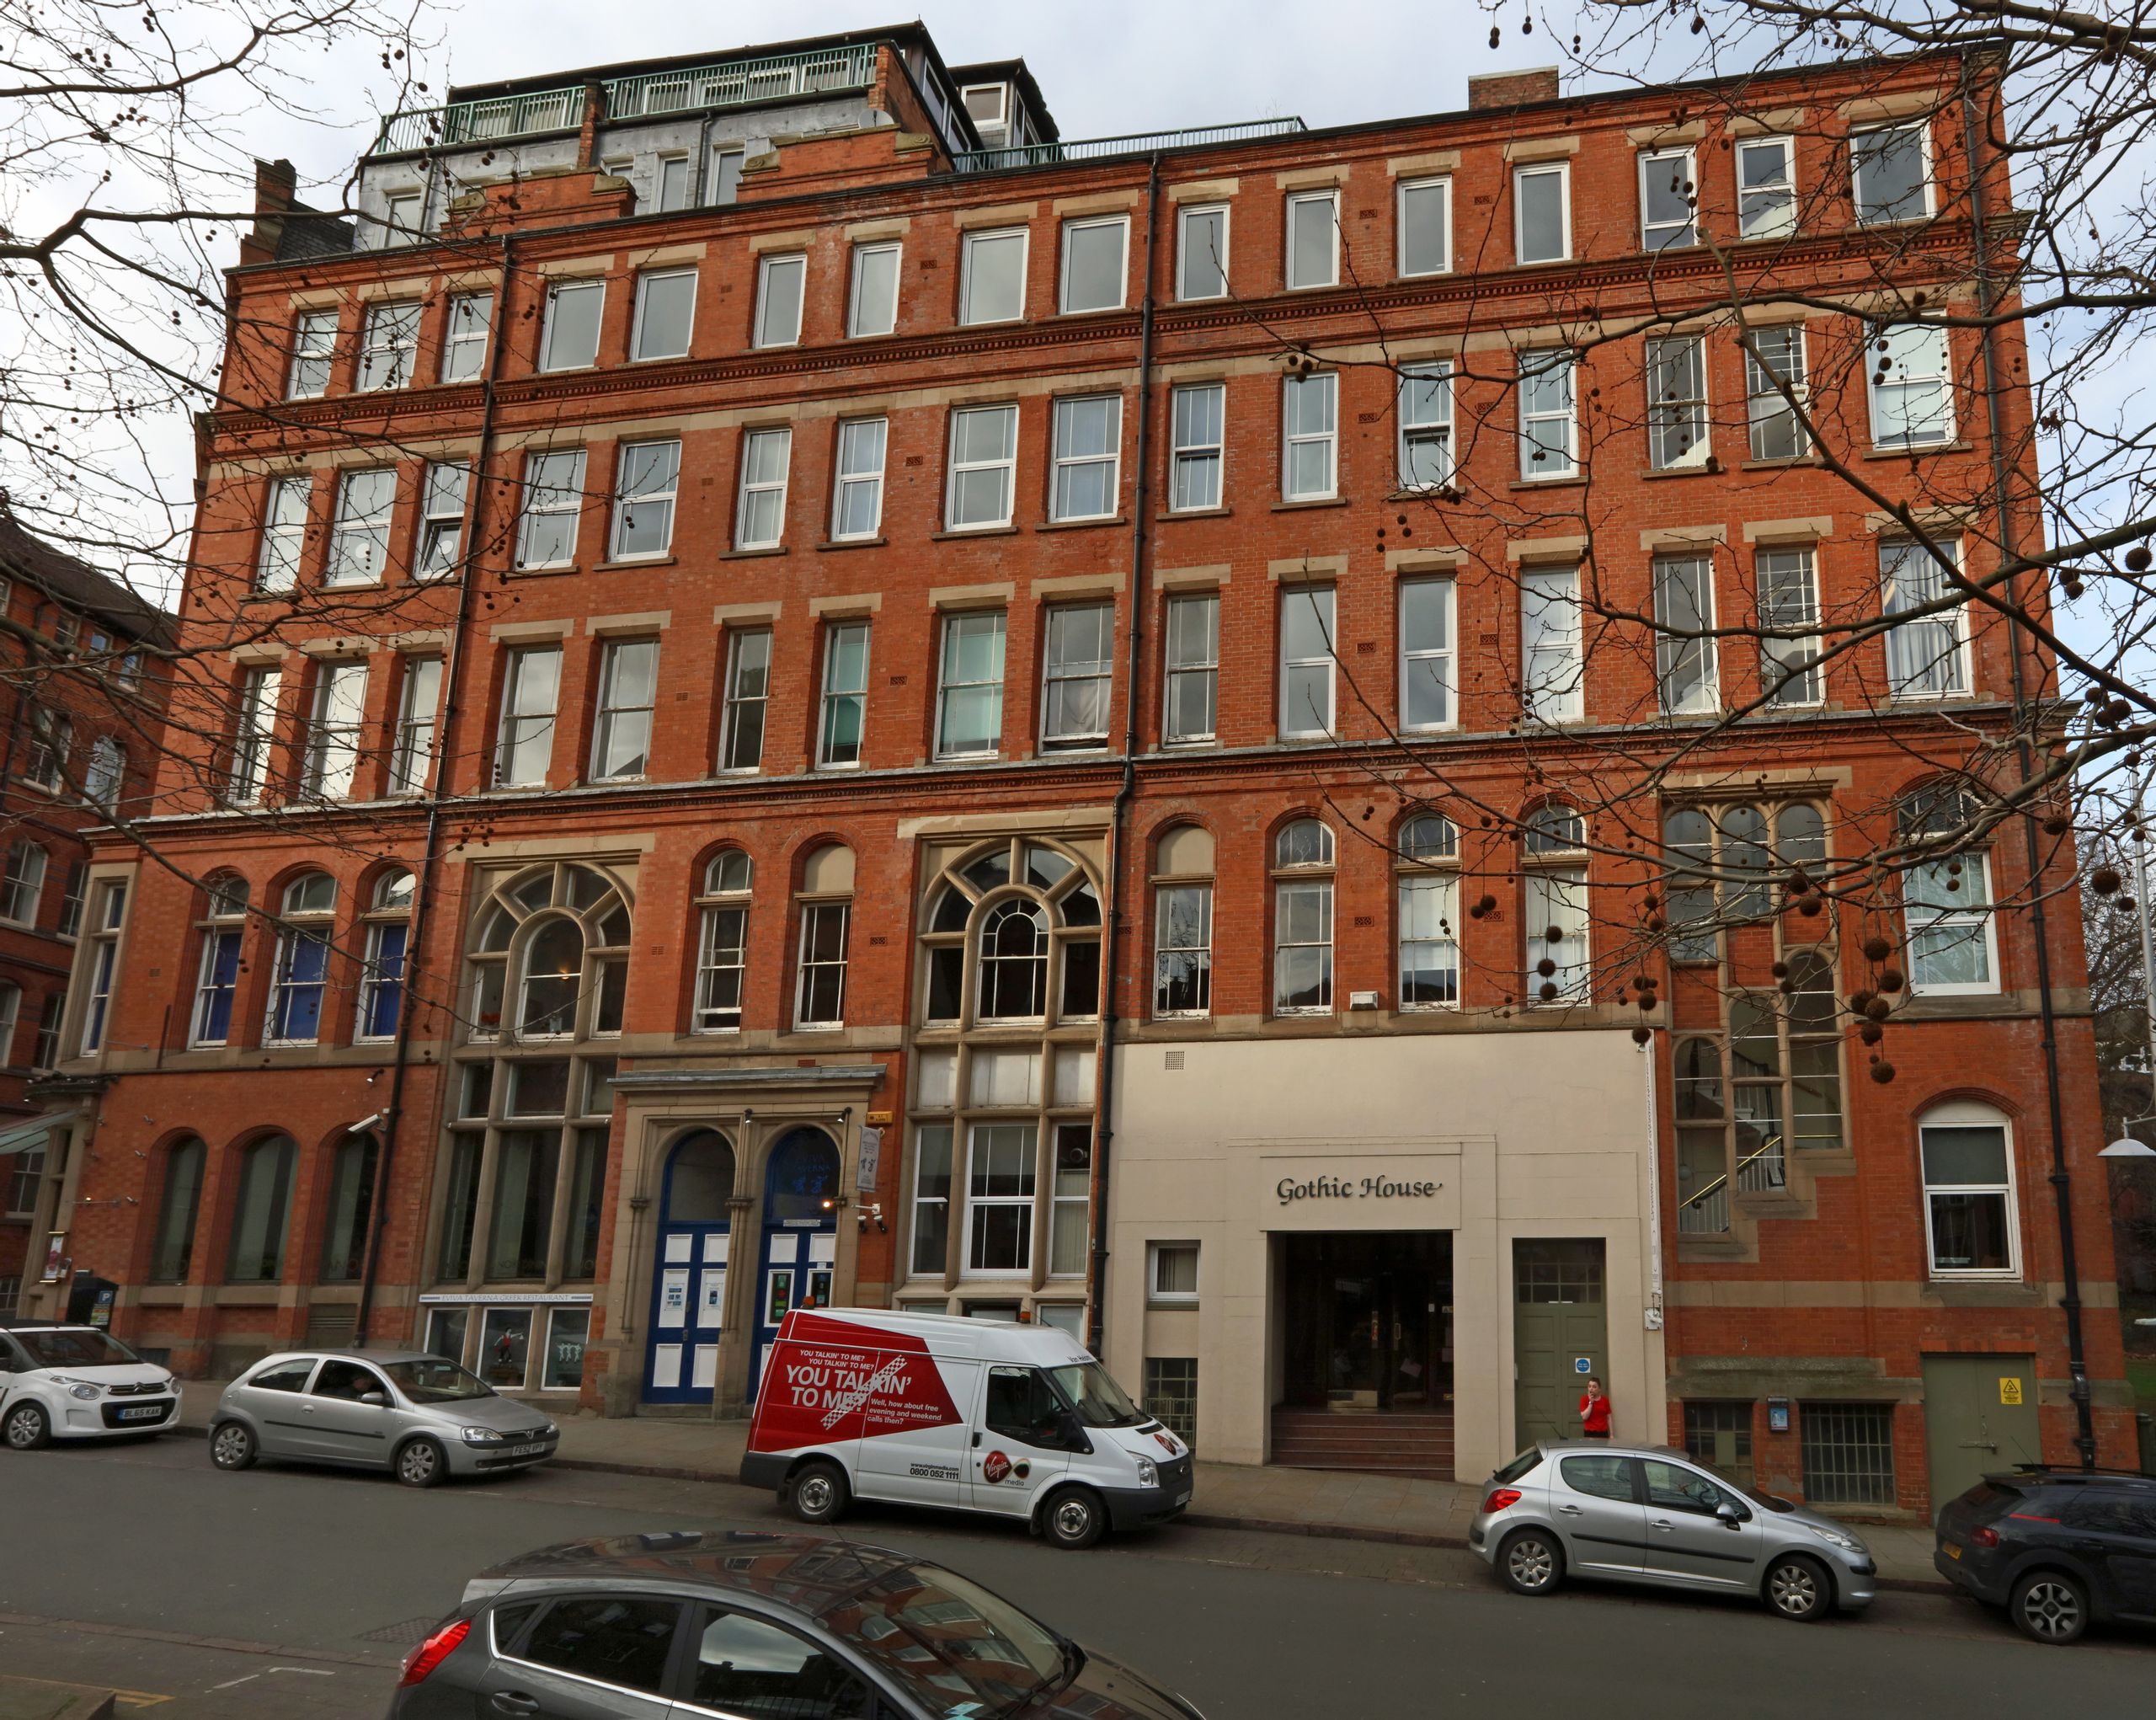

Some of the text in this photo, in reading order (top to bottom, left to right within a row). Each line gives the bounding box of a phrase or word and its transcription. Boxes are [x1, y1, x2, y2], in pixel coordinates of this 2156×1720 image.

[1277, 1174, 1443, 1205] Gothic House
[102, 1293, 110, 1301] P
[814, 1350, 840, 1359] TALKIN'
[824, 1359, 848, 1368] TALKIN'
[787, 1365, 911, 1395] YOU TALKIN'
[792, 1386, 819, 1408] TO
[871, 1397, 887, 1407] Well,
[869, 1408, 895, 1416] evening
[911, 1413, 942, 1421] weekend
[884, 1416, 904, 1424] then?
[910, 1462, 959, 1471] www.virginmedia.com
[986, 1456, 1009, 1478] Virgin
[910, 1467, 959, 1480] 0800 052 1111
